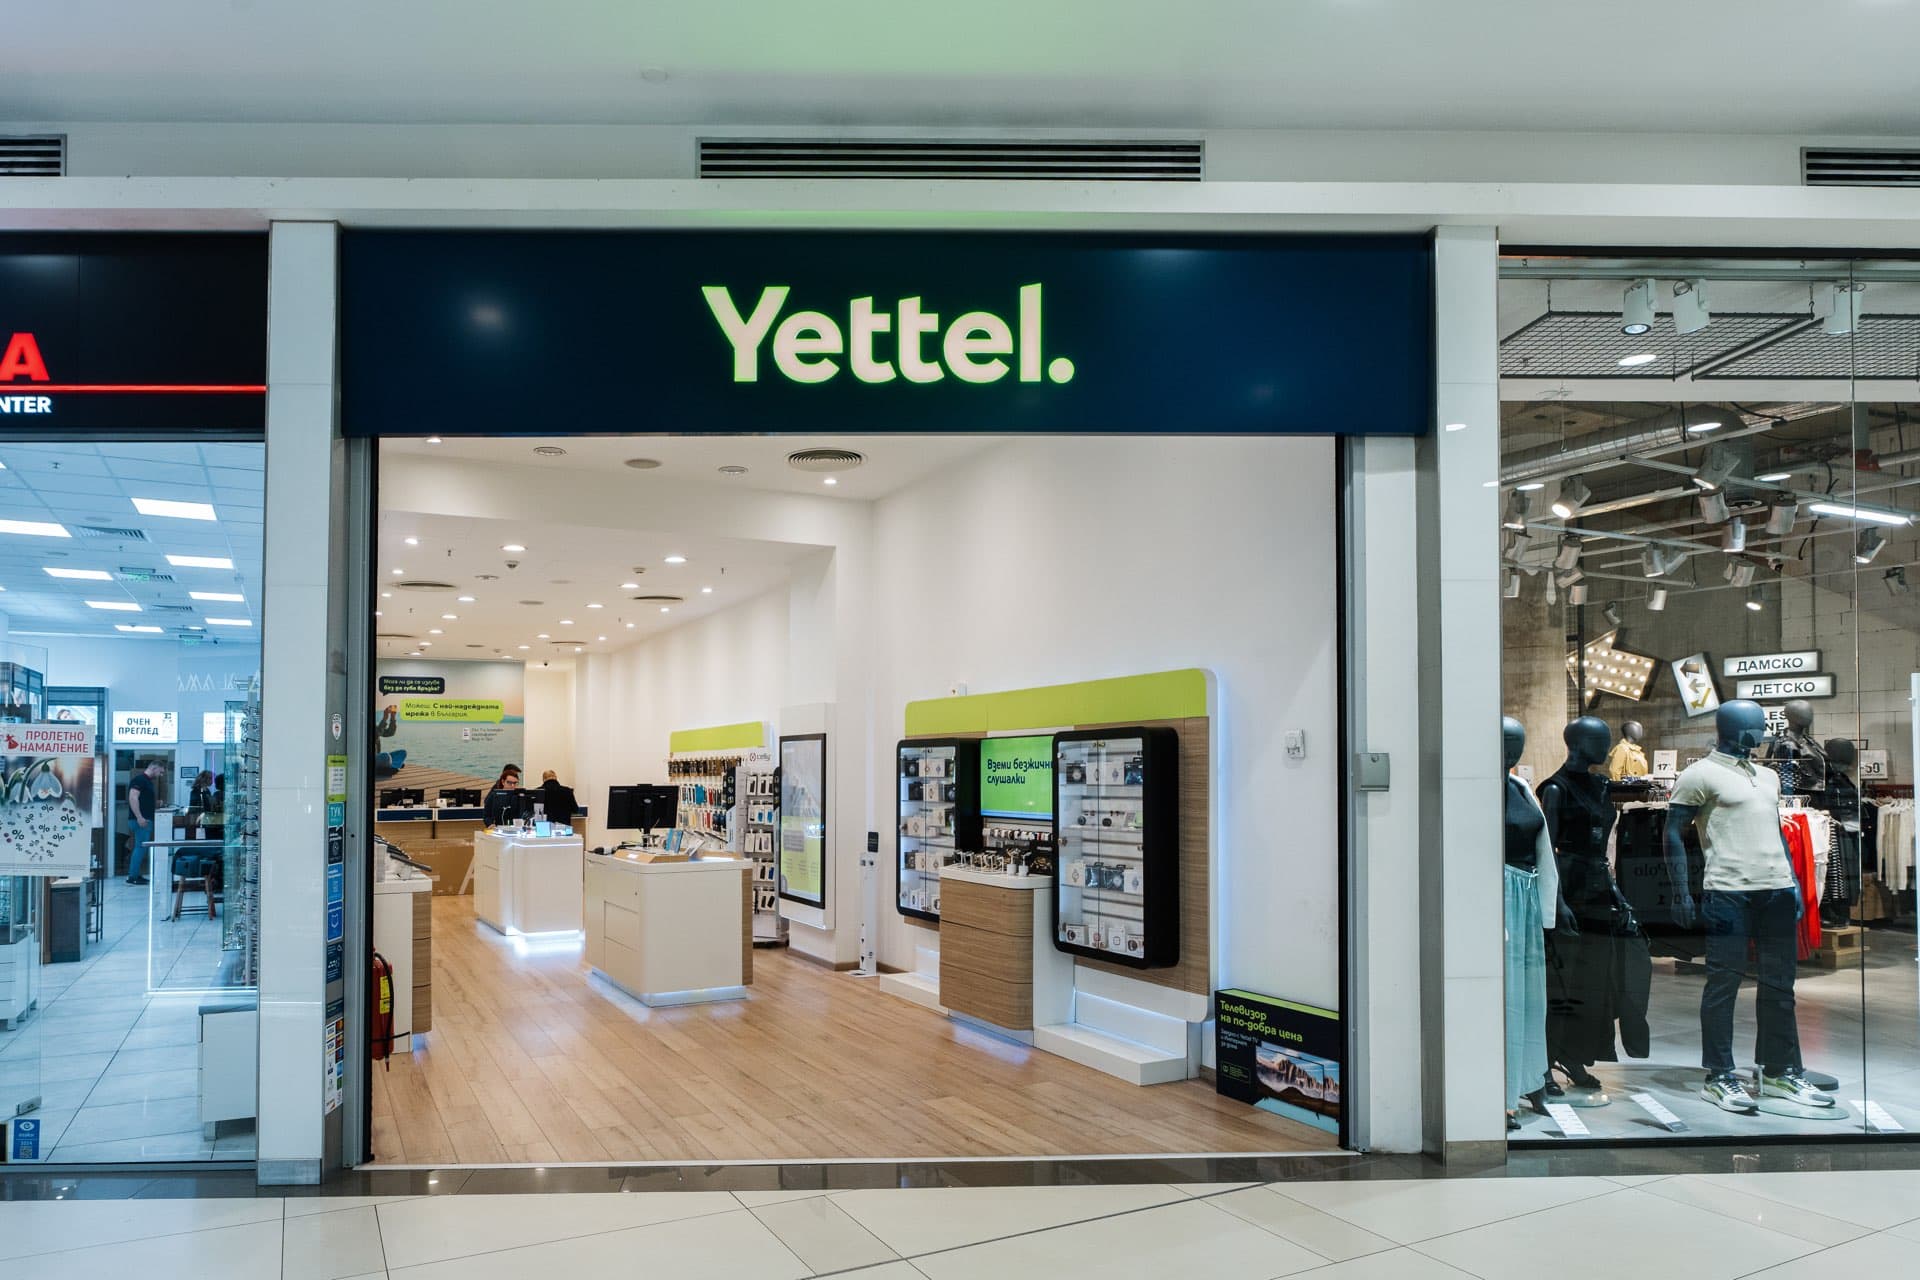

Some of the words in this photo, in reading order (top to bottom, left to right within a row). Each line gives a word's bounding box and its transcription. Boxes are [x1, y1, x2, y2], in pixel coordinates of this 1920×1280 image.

[701, 283, 1075, 384] Yettel.
[1737, 657, 1803, 673] ДАМСКО
[1751, 681, 1816, 697] ДЕТСКО
[126, 717, 151, 726] ОЧЕН
[25, 730, 85, 742] ПРОЛЕТНО
[118, 726, 160, 736] ПРЕГЛЕД
[19, 742, 89, 754] НАМАЛЕНИЕ
[987, 758, 1011, 772] Вземи
[987, 773, 1025, 786] слушалки
[1220, 1001, 1267, 1020] Телевизор
[1220, 1013, 1232, 1023] на
[1233, 1016, 1277, 1036] по-добра
[1278, 1028, 1303, 1042] цена
